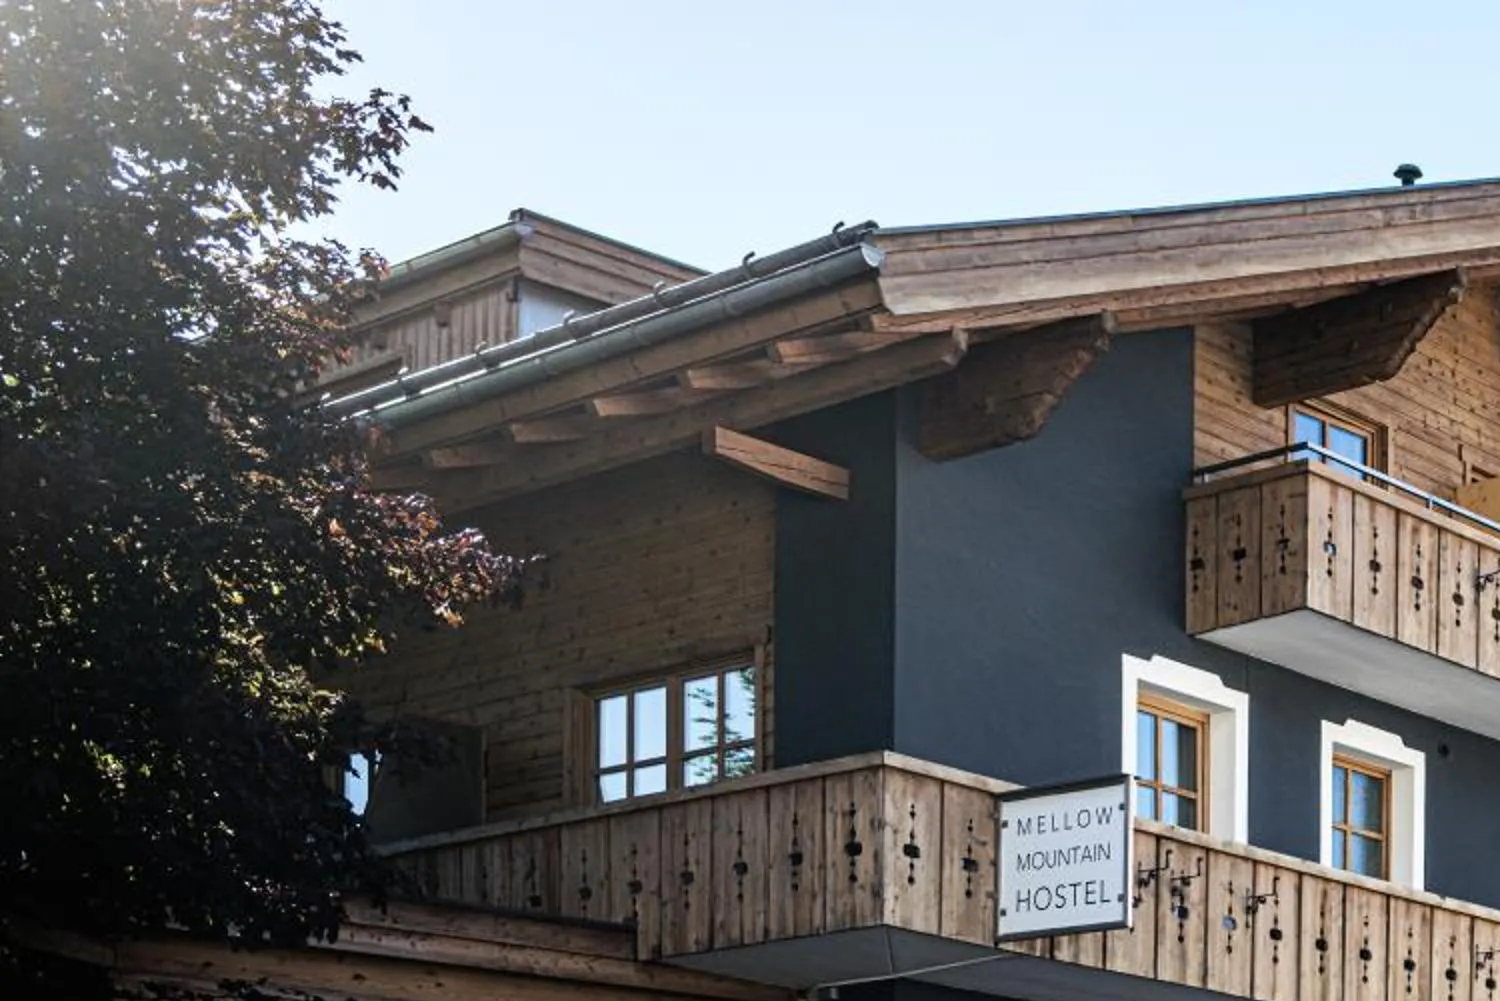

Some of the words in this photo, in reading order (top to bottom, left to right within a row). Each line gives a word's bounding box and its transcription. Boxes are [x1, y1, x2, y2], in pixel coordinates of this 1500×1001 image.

[1016, 806, 1113, 836] MELLOW
[1016, 842, 1111, 871] MOUNTAIN
[1015, 880, 1111, 912] HOSTEL
